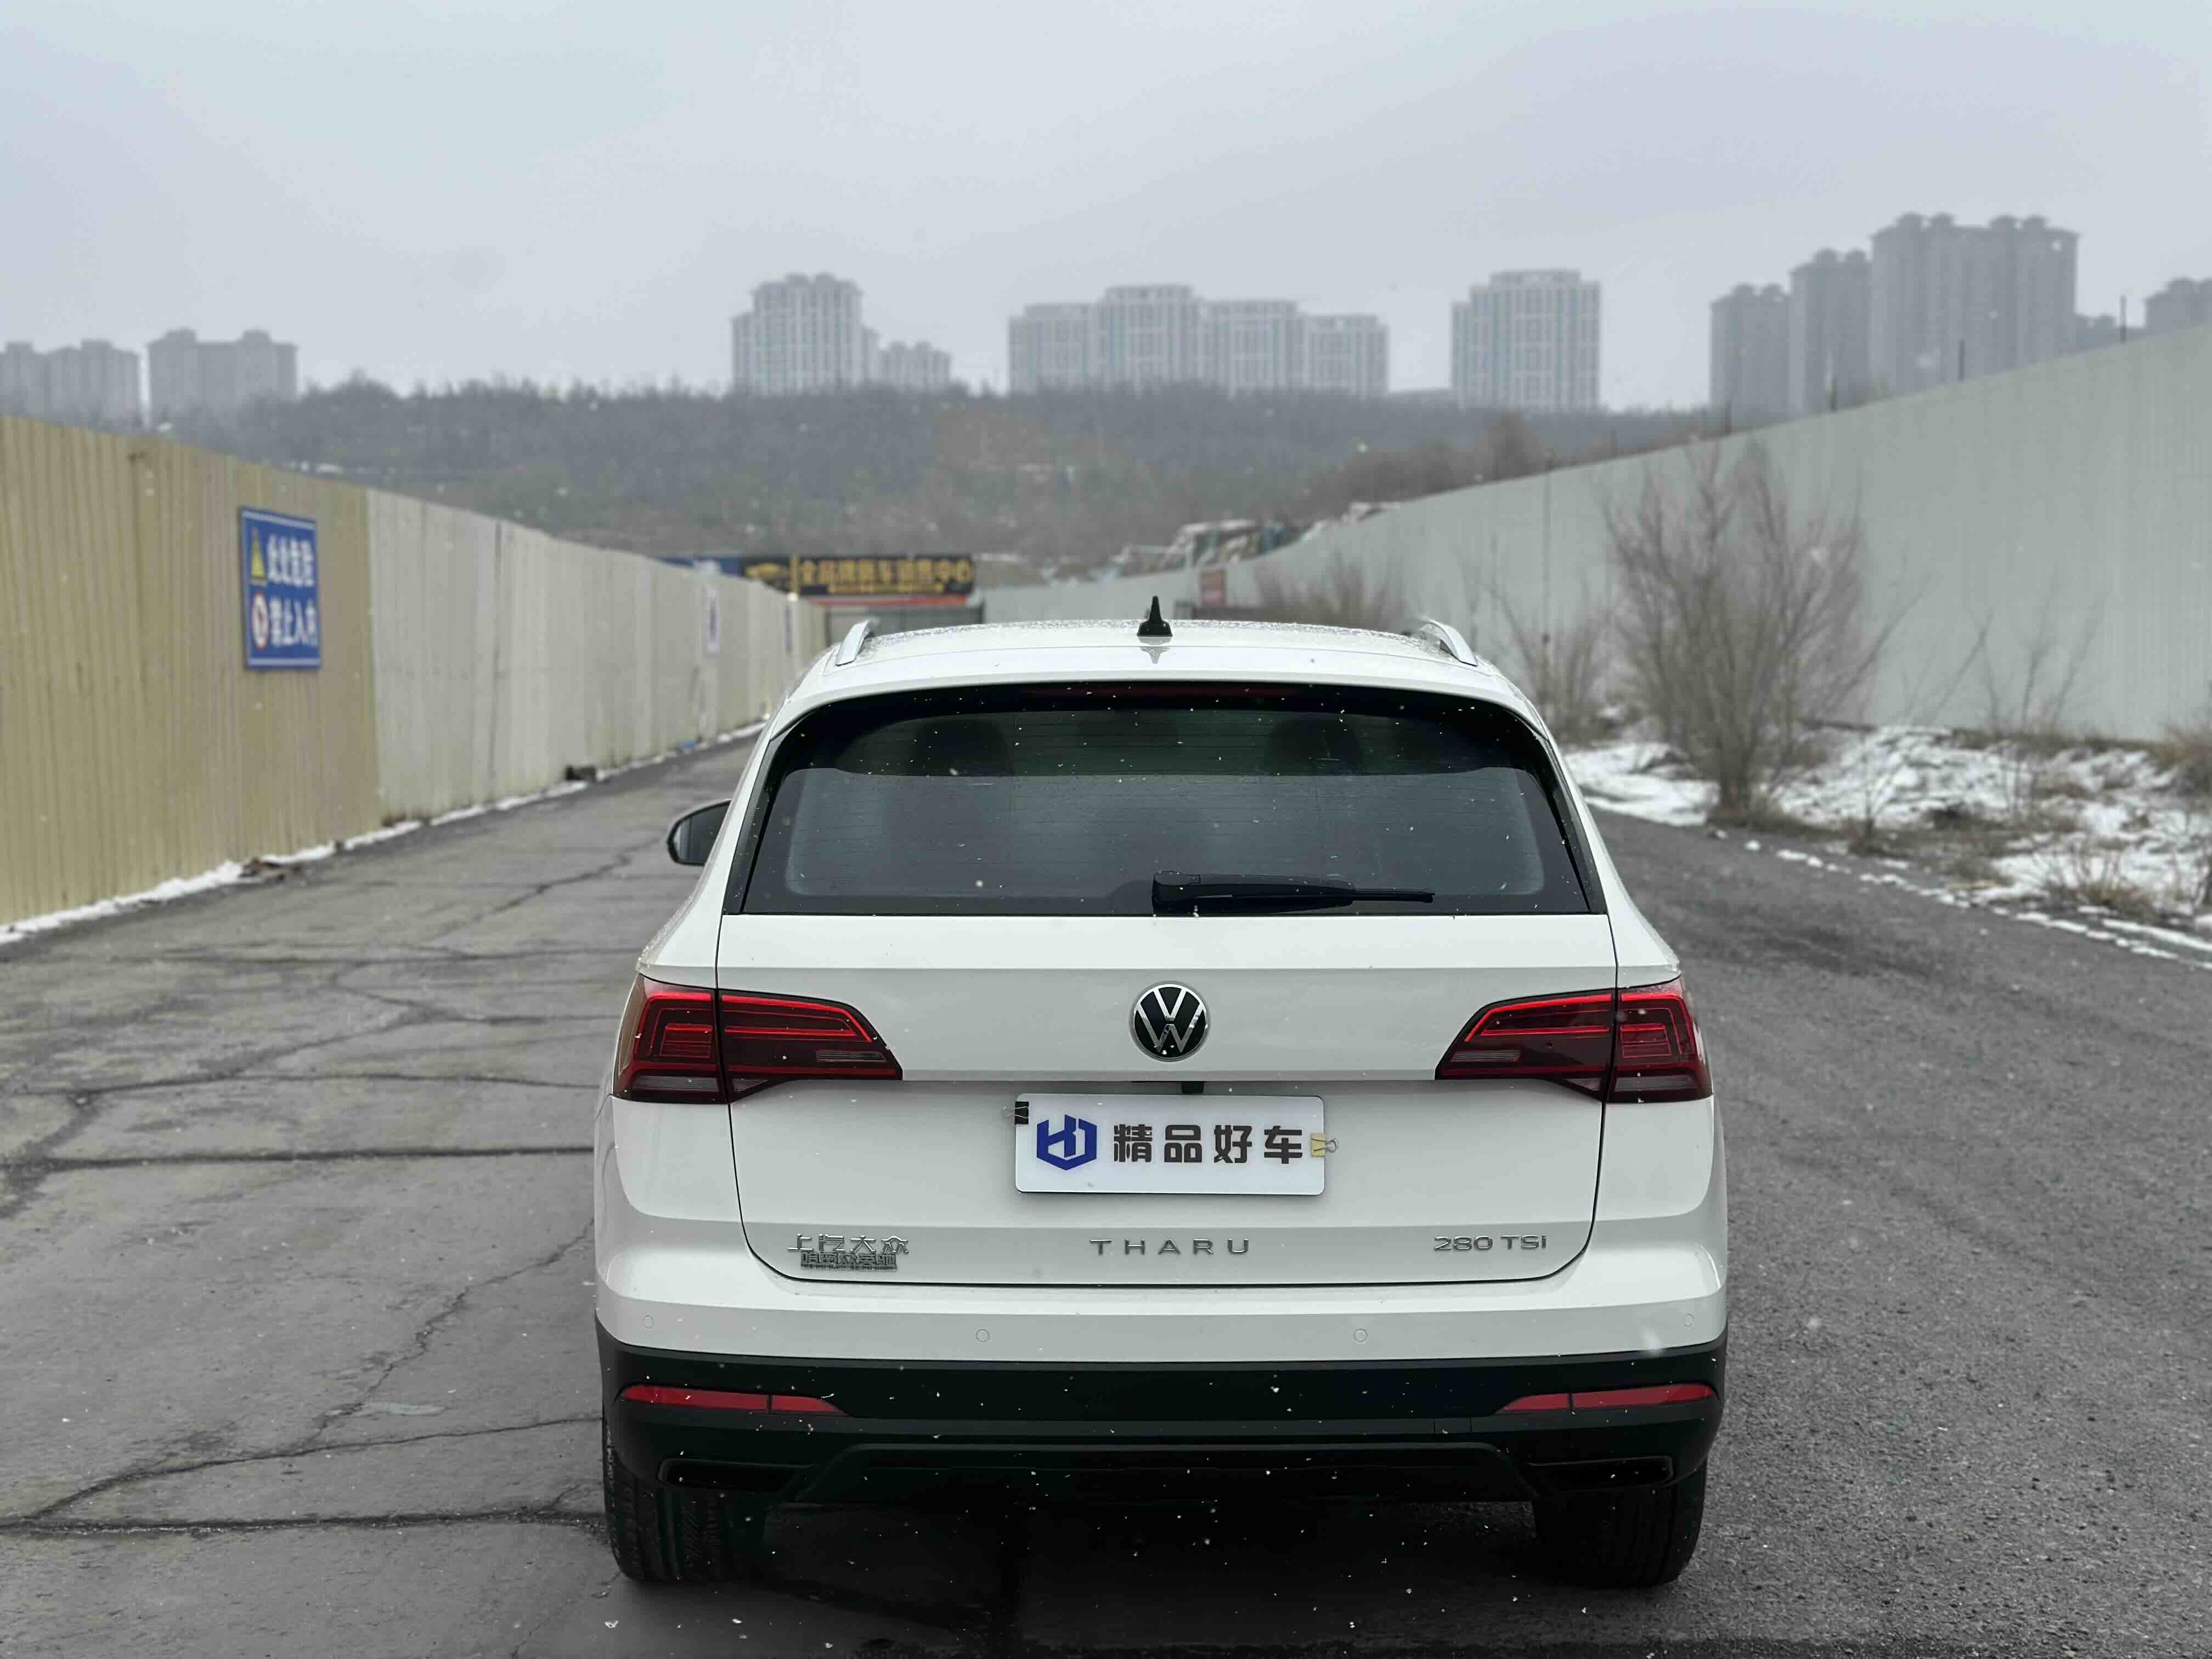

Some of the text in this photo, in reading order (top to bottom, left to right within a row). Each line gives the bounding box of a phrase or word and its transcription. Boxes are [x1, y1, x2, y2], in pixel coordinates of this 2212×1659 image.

[1113, 1124, 1304, 1164] 精品好车
[787, 1233, 909, 1254] 上汽大众
[1089, 1238, 1250, 1255] THARU
[1434, 1236, 1493, 1251] 280
